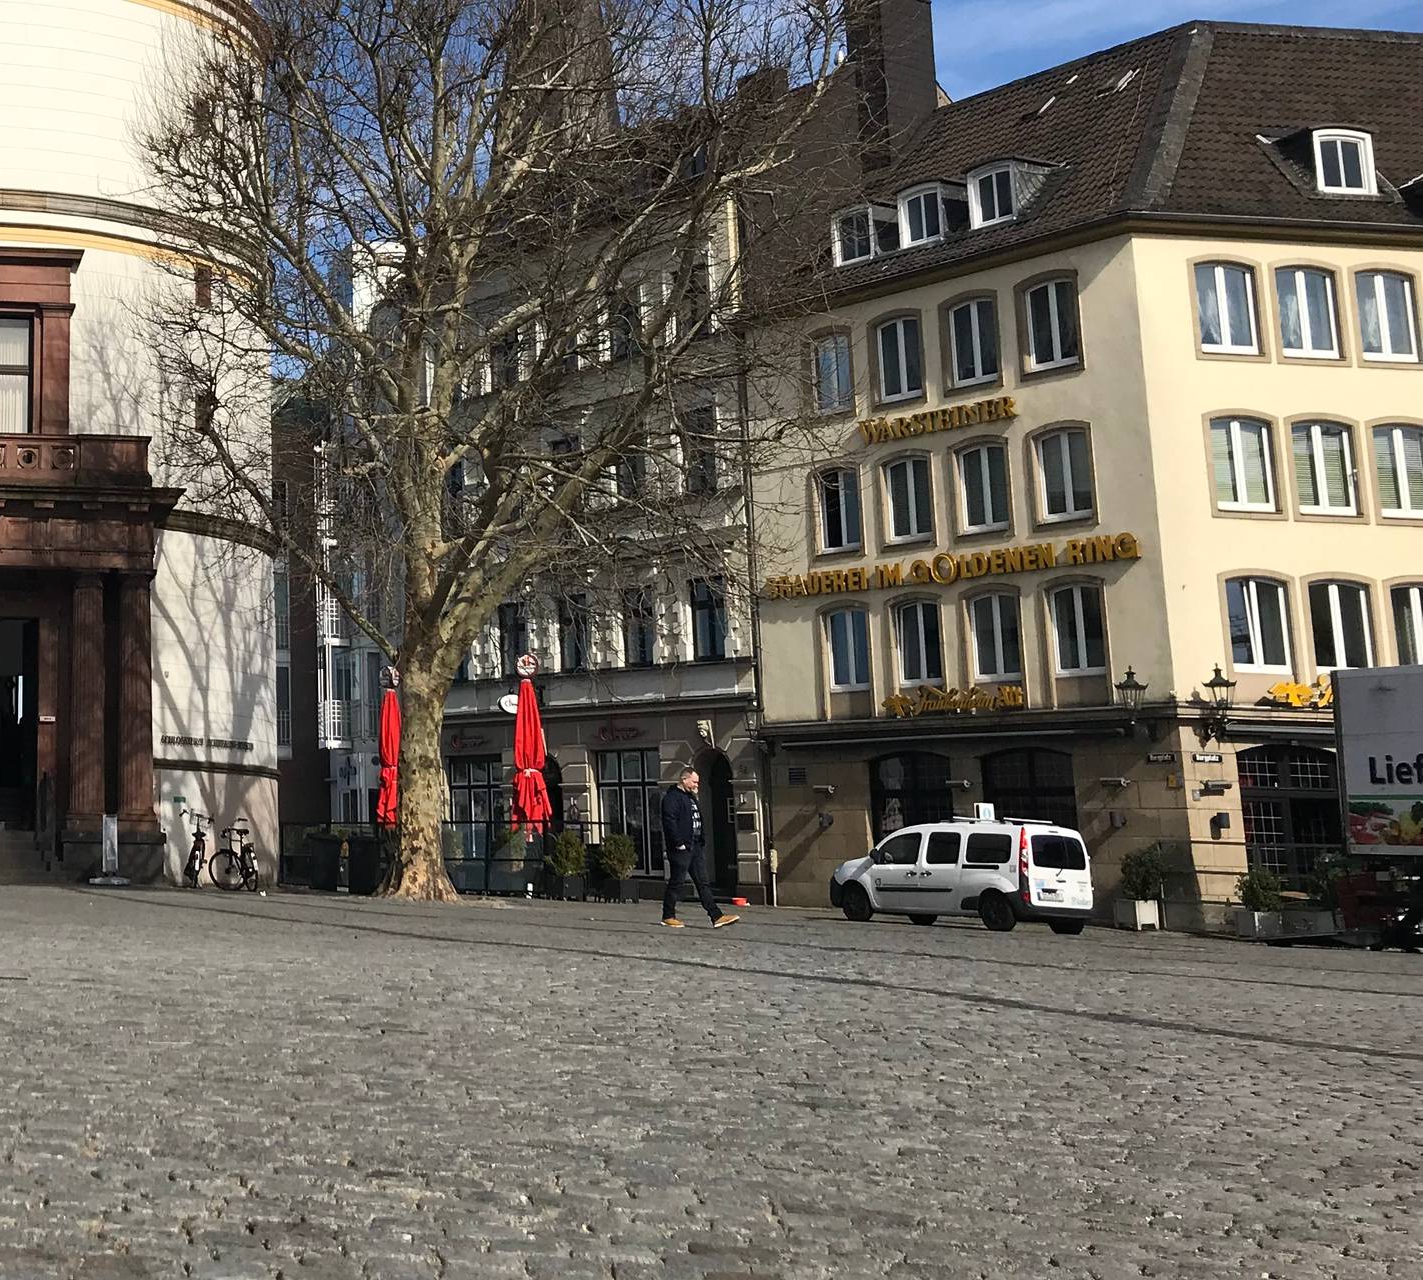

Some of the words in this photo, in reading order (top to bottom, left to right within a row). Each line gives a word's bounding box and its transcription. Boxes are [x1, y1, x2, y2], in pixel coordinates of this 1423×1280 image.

[858, 397, 1018, 447] WARSTEINER
[766, 566, 869, 599] BRAUEREI
[875, 563, 904, 589] IM
[910, 542, 1056, 585] GOLDENEN
[1066, 532, 1141, 565] RING
